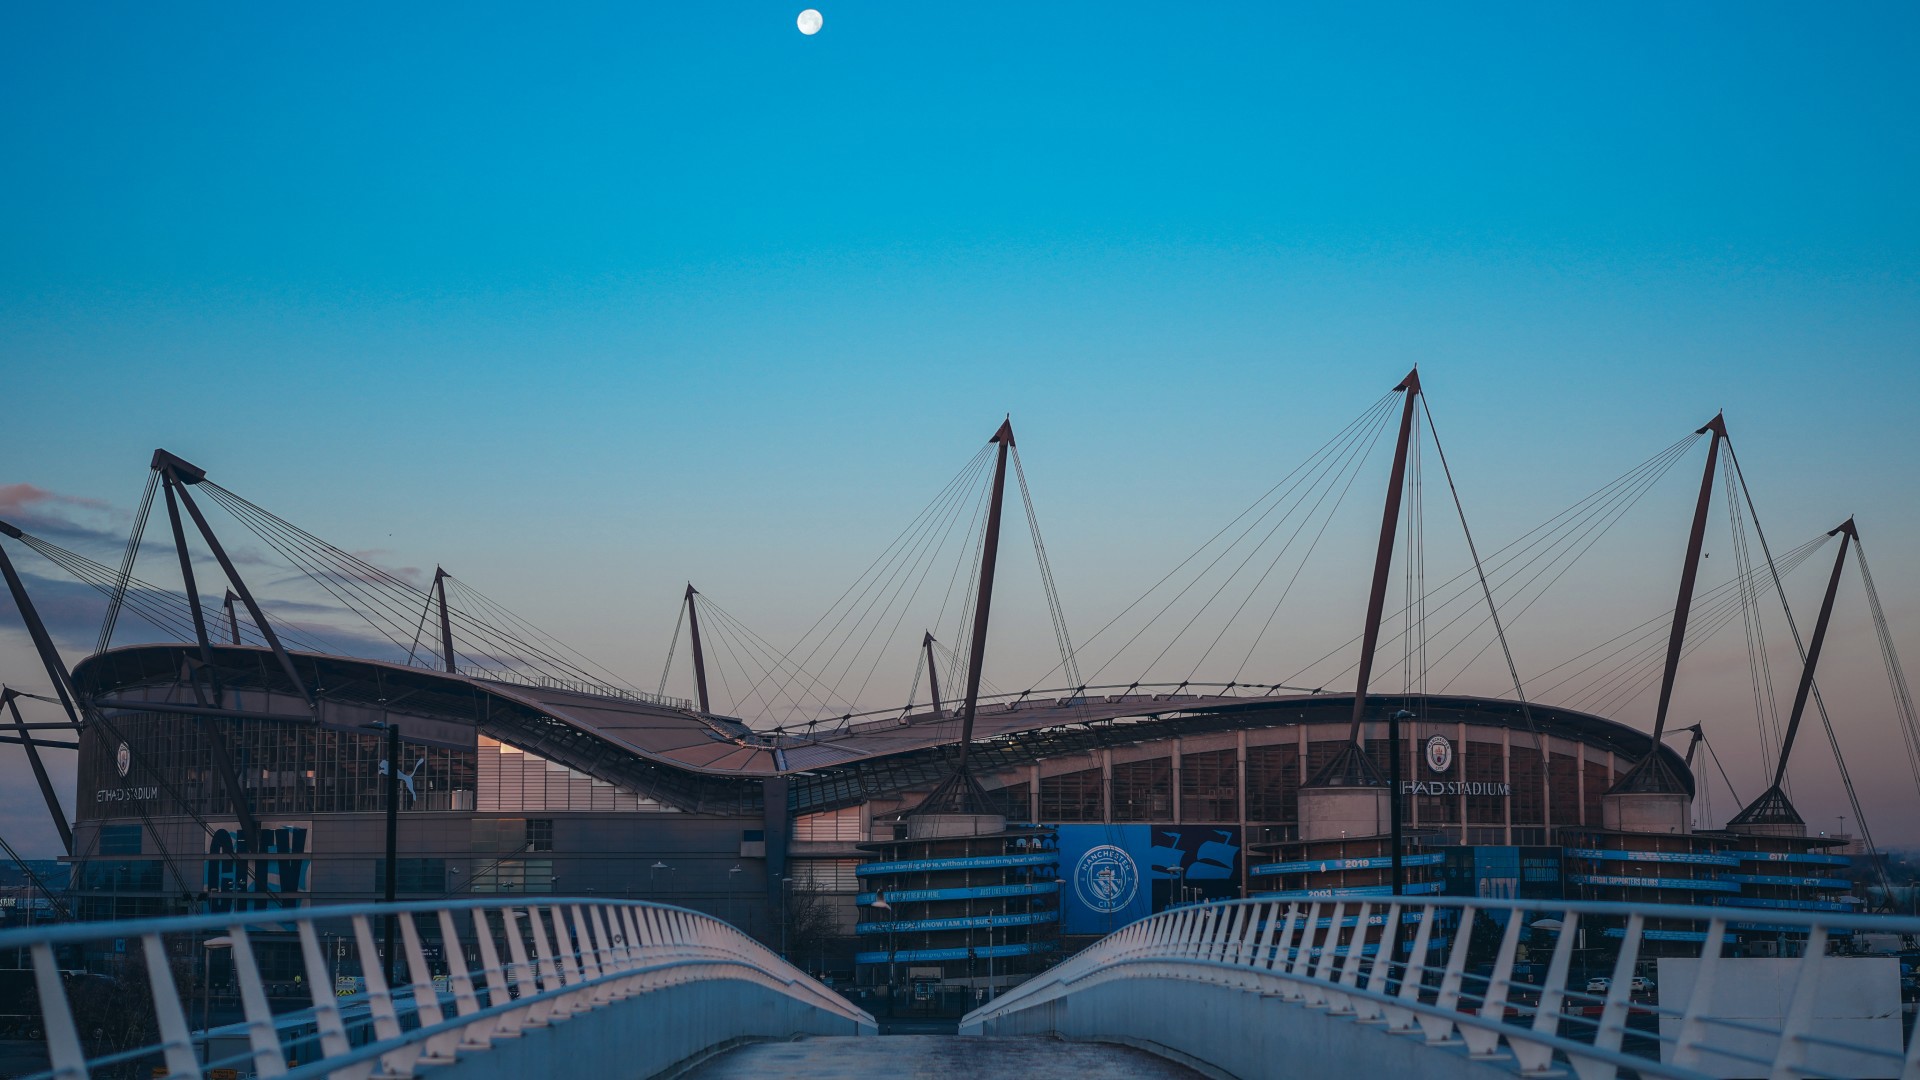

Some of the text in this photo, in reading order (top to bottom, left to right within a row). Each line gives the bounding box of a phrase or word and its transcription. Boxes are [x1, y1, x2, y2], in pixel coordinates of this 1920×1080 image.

[97, 786, 158, 802] ETIHAD STADIUM
[1448, 782, 1508, 795] STADIUM
[1082, 850, 1130, 871] MANCHESTER
[1345, 860, 1370, 868] 2019
[1609, 878, 1640, 886] SUPPORTERS
